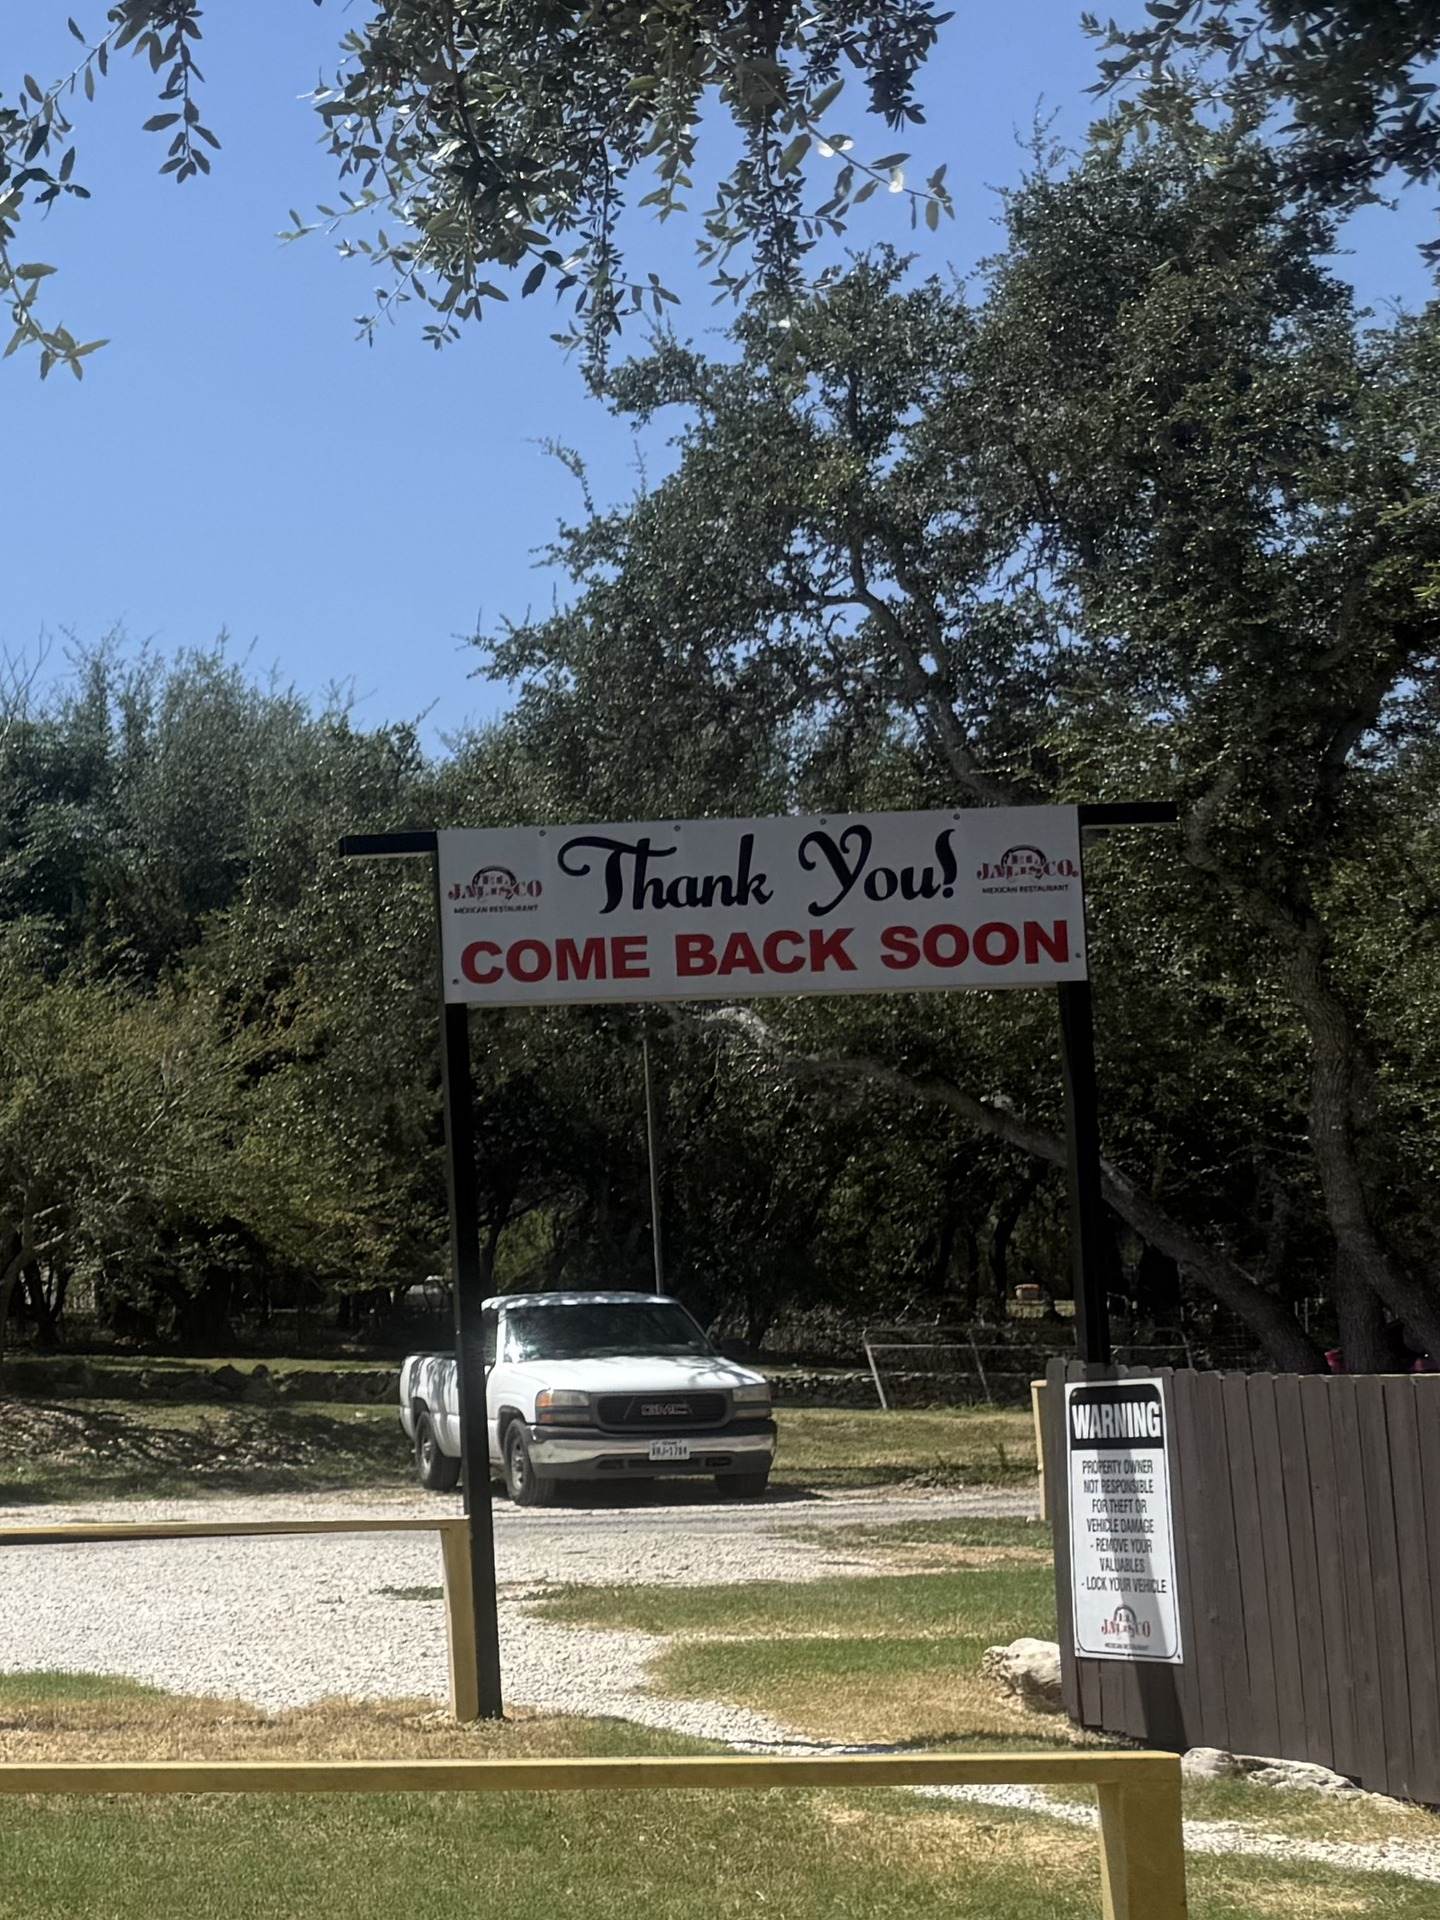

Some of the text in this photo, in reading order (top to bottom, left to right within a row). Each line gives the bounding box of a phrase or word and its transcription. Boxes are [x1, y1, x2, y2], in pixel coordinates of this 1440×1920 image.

[557, 824, 958, 917] Thank You!
[461, 919, 1070, 984] COME BACK SOON
[1071, 1401, 1161, 1439] WARNING
[1082, 1459, 1153, 1474] PROPERTY OWNER
[1083, 1479, 1154, 1494] NOT RESPONSIBLE
[1092, 1499, 1147, 1514] FOR THEFT OR
[1087, 1518, 1154, 1533] VEHICLE DAMAGE
[1096, 1538, 1128, 1552] REMOVE
[1131, 1538, 1152, 1553] YOUR
[1099, 1558, 1145, 1572] VALUABLES
[1086, 1576, 1107, 1591] LOCK
[1109, 1577, 1131, 1592] YOUR
[1132, 1577, 1167, 1593] VEHICLE
